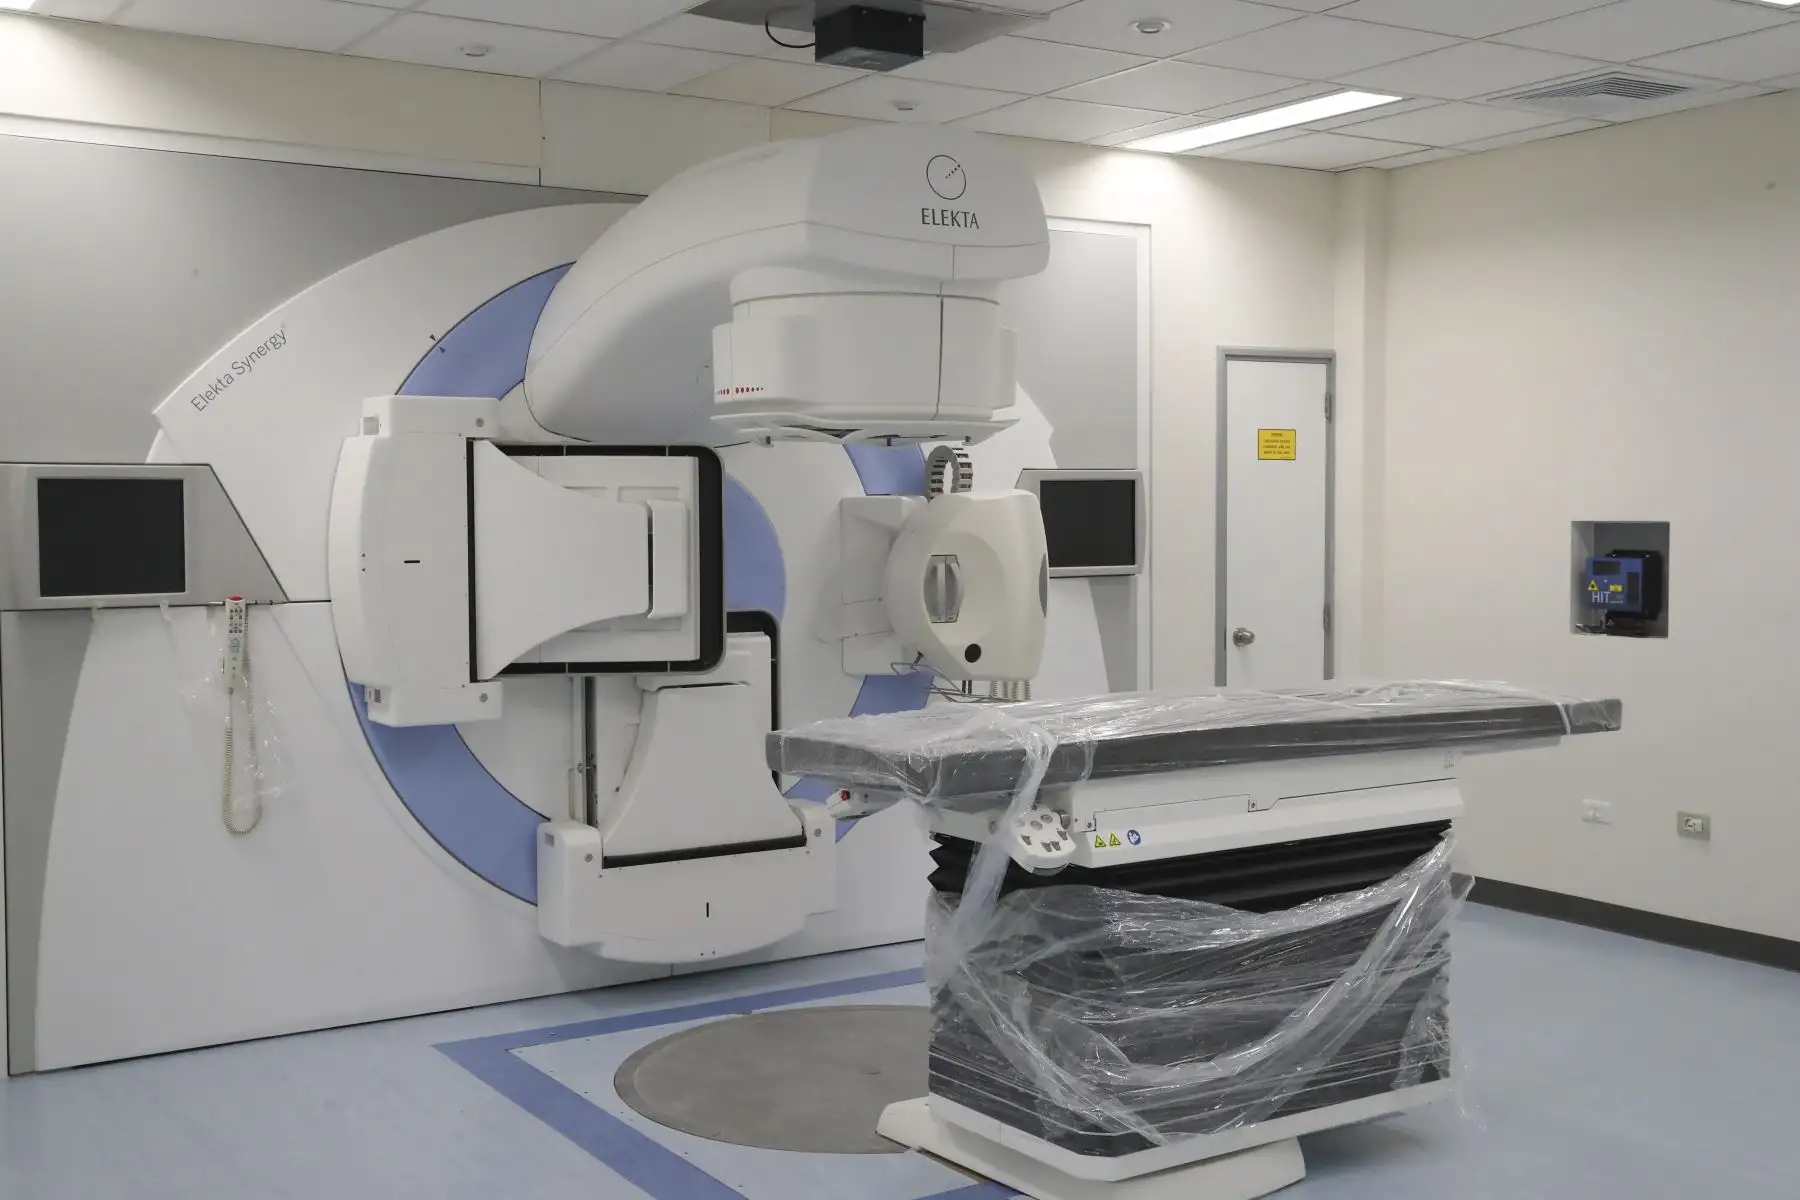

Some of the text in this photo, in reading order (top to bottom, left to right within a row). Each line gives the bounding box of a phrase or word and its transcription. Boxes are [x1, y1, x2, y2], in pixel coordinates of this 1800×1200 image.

[921, 207, 980, 230] ELEKTA
[190, 329, 287, 412] Elekta Synergy
[1591, 591, 1611, 604] HIT
